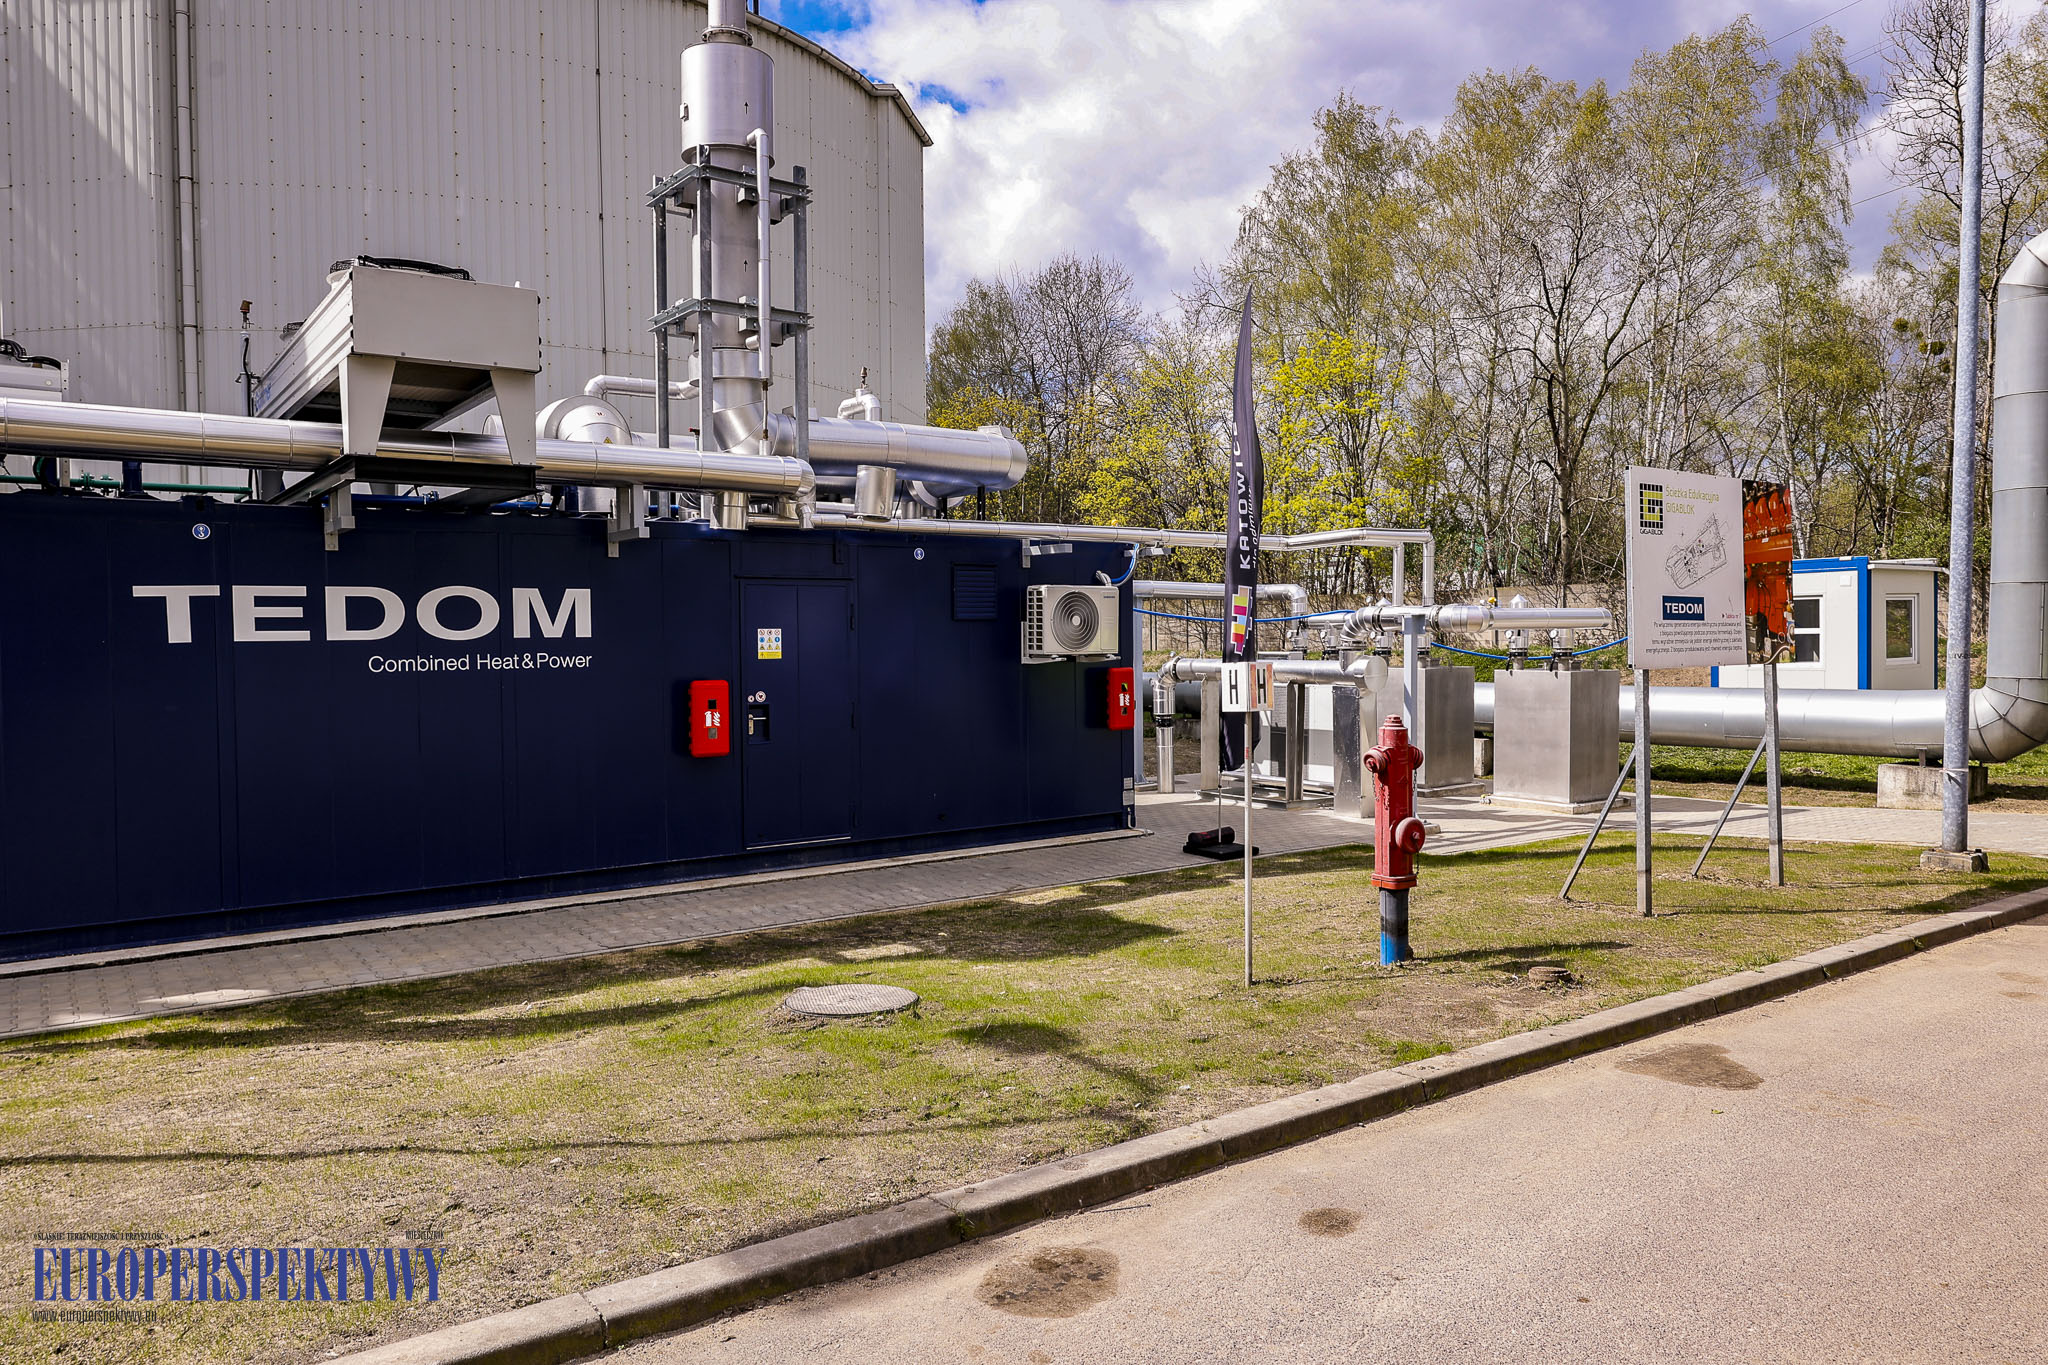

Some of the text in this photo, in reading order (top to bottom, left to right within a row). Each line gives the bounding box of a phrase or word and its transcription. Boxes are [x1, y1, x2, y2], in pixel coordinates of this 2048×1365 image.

[132, 584, 592, 644] TEDOM
[1664, 602, 1703, 614] TEDOM
[368, 653, 470, 673] Combined
[1229, 669, 1239, 705] H
[1256, 668, 1267, 705] H
